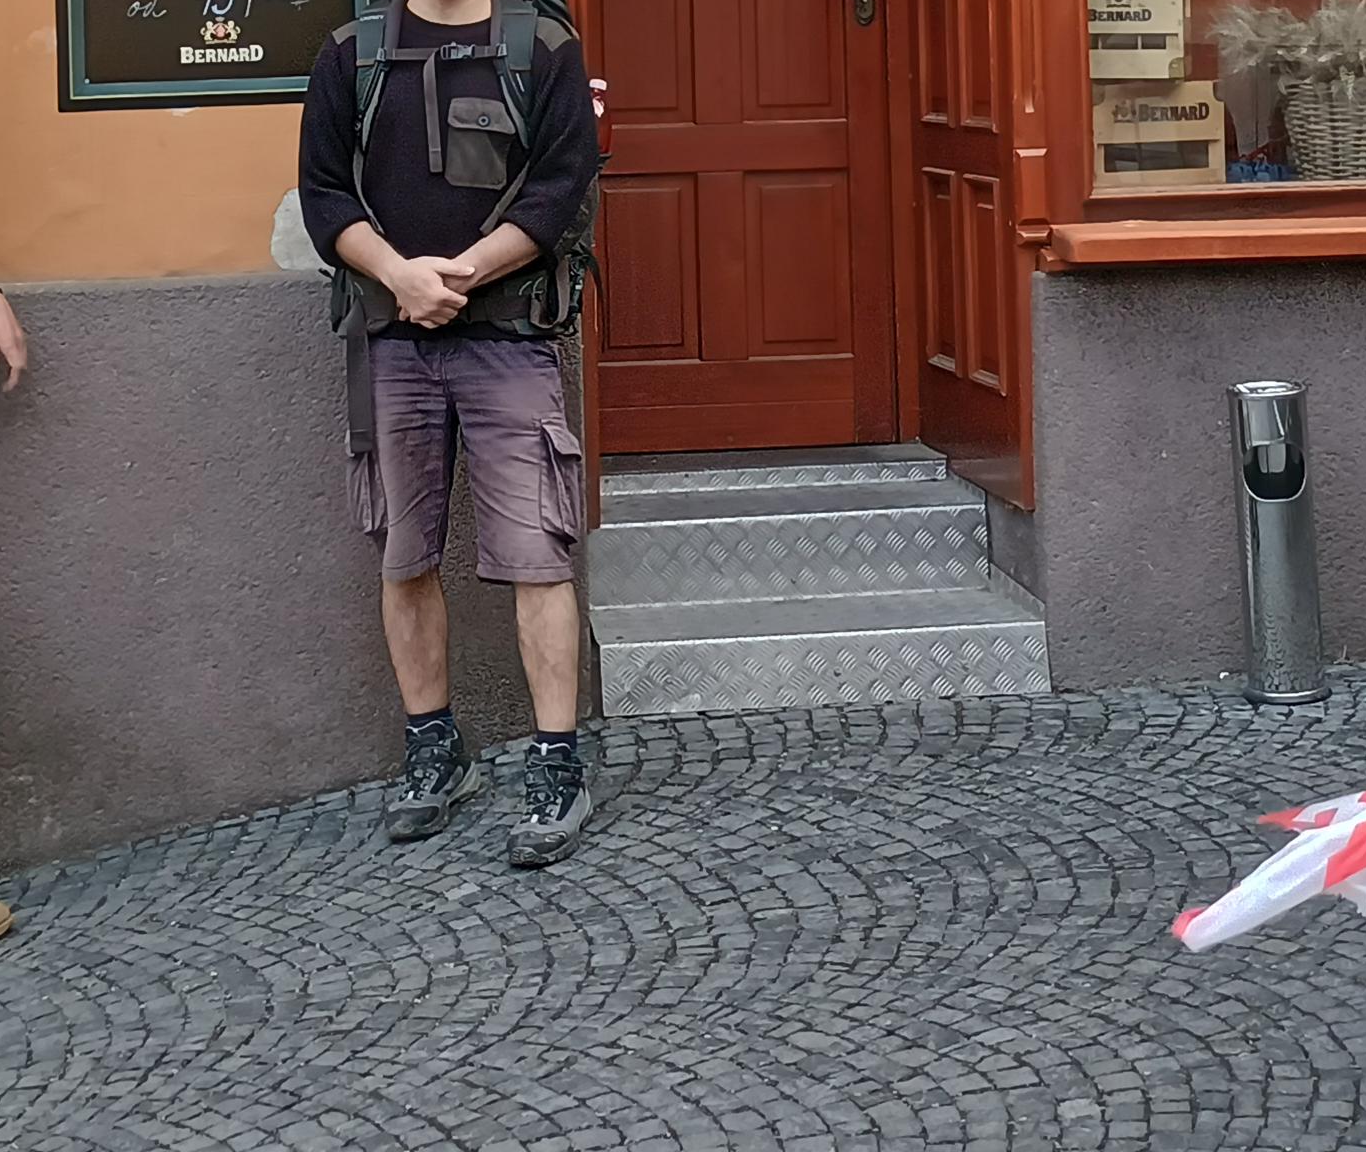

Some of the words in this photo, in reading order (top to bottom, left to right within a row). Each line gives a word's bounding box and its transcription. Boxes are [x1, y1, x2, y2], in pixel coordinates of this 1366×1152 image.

[1088, 8, 1153, 23] BERNARD
[180, 44, 265, 64] BERNARD
[1138, 102, 1210, 122] BERNARD
